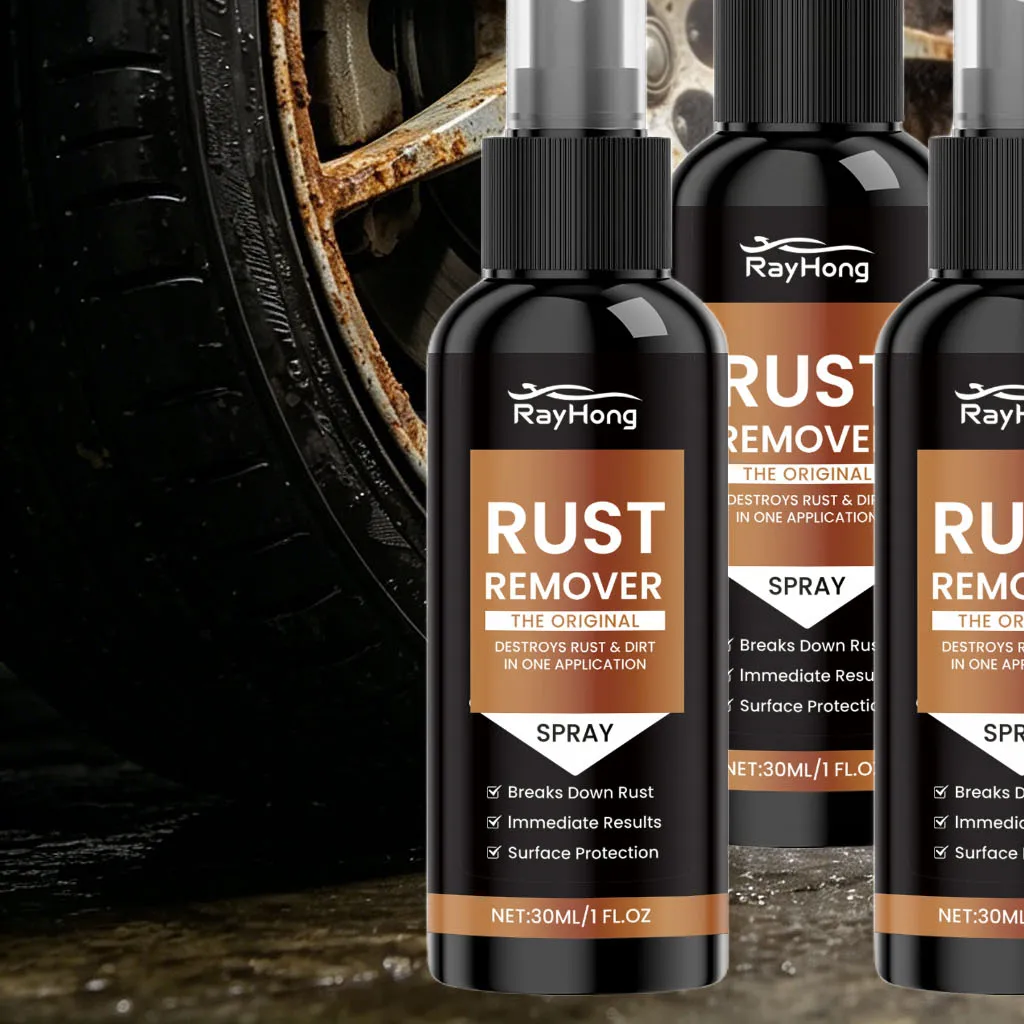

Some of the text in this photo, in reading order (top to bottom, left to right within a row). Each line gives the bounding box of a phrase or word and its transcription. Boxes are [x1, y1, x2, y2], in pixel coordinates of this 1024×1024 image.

[746, 256, 869, 284] RayHong
[513, 403, 637, 431] RayHong
[728, 425, 875, 453] EMOVE
[743, 467, 872, 481] THE ORIGINAL
[728, 494, 875, 506] DESTROYS RUST & DI
[736, 512, 875, 523] IN ONE APPLICATION
[487, 501, 666, 555] RUST
[485, 572, 662, 600] REMOVER
[769, 576, 846, 596] SPRAY
[511, 614, 640, 628] THE ORIGINAL
[958, 614, 991, 628] THE
[495, 641, 656, 653] DESTROYS RUST & DIRT
[740, 638, 876, 652] Breaks Down Ru
[942, 641, 1014, 653] DESTROYS
[504, 658, 647, 670] IN ONE APPLICATION
[951, 658, 965, 670] IN
[969, 658, 998, 670] ONE
[740, 668, 875, 682] Immediate Resu
[740, 698, 876, 713] Surface Protecti
[537, 723, 614, 743] SPRAY
[835, 761, 876, 777] FL.O
[508, 785, 654, 799] Breaks Down Rust
[955, 785, 1010, 799] Breaks
[508, 815, 662, 830] Immediate Results
[508, 846, 659, 860] Surface Protection
[955, 846, 1018, 860] Surface
[491, 904, 651, 928] NET:30ML/1 FL.OZ
